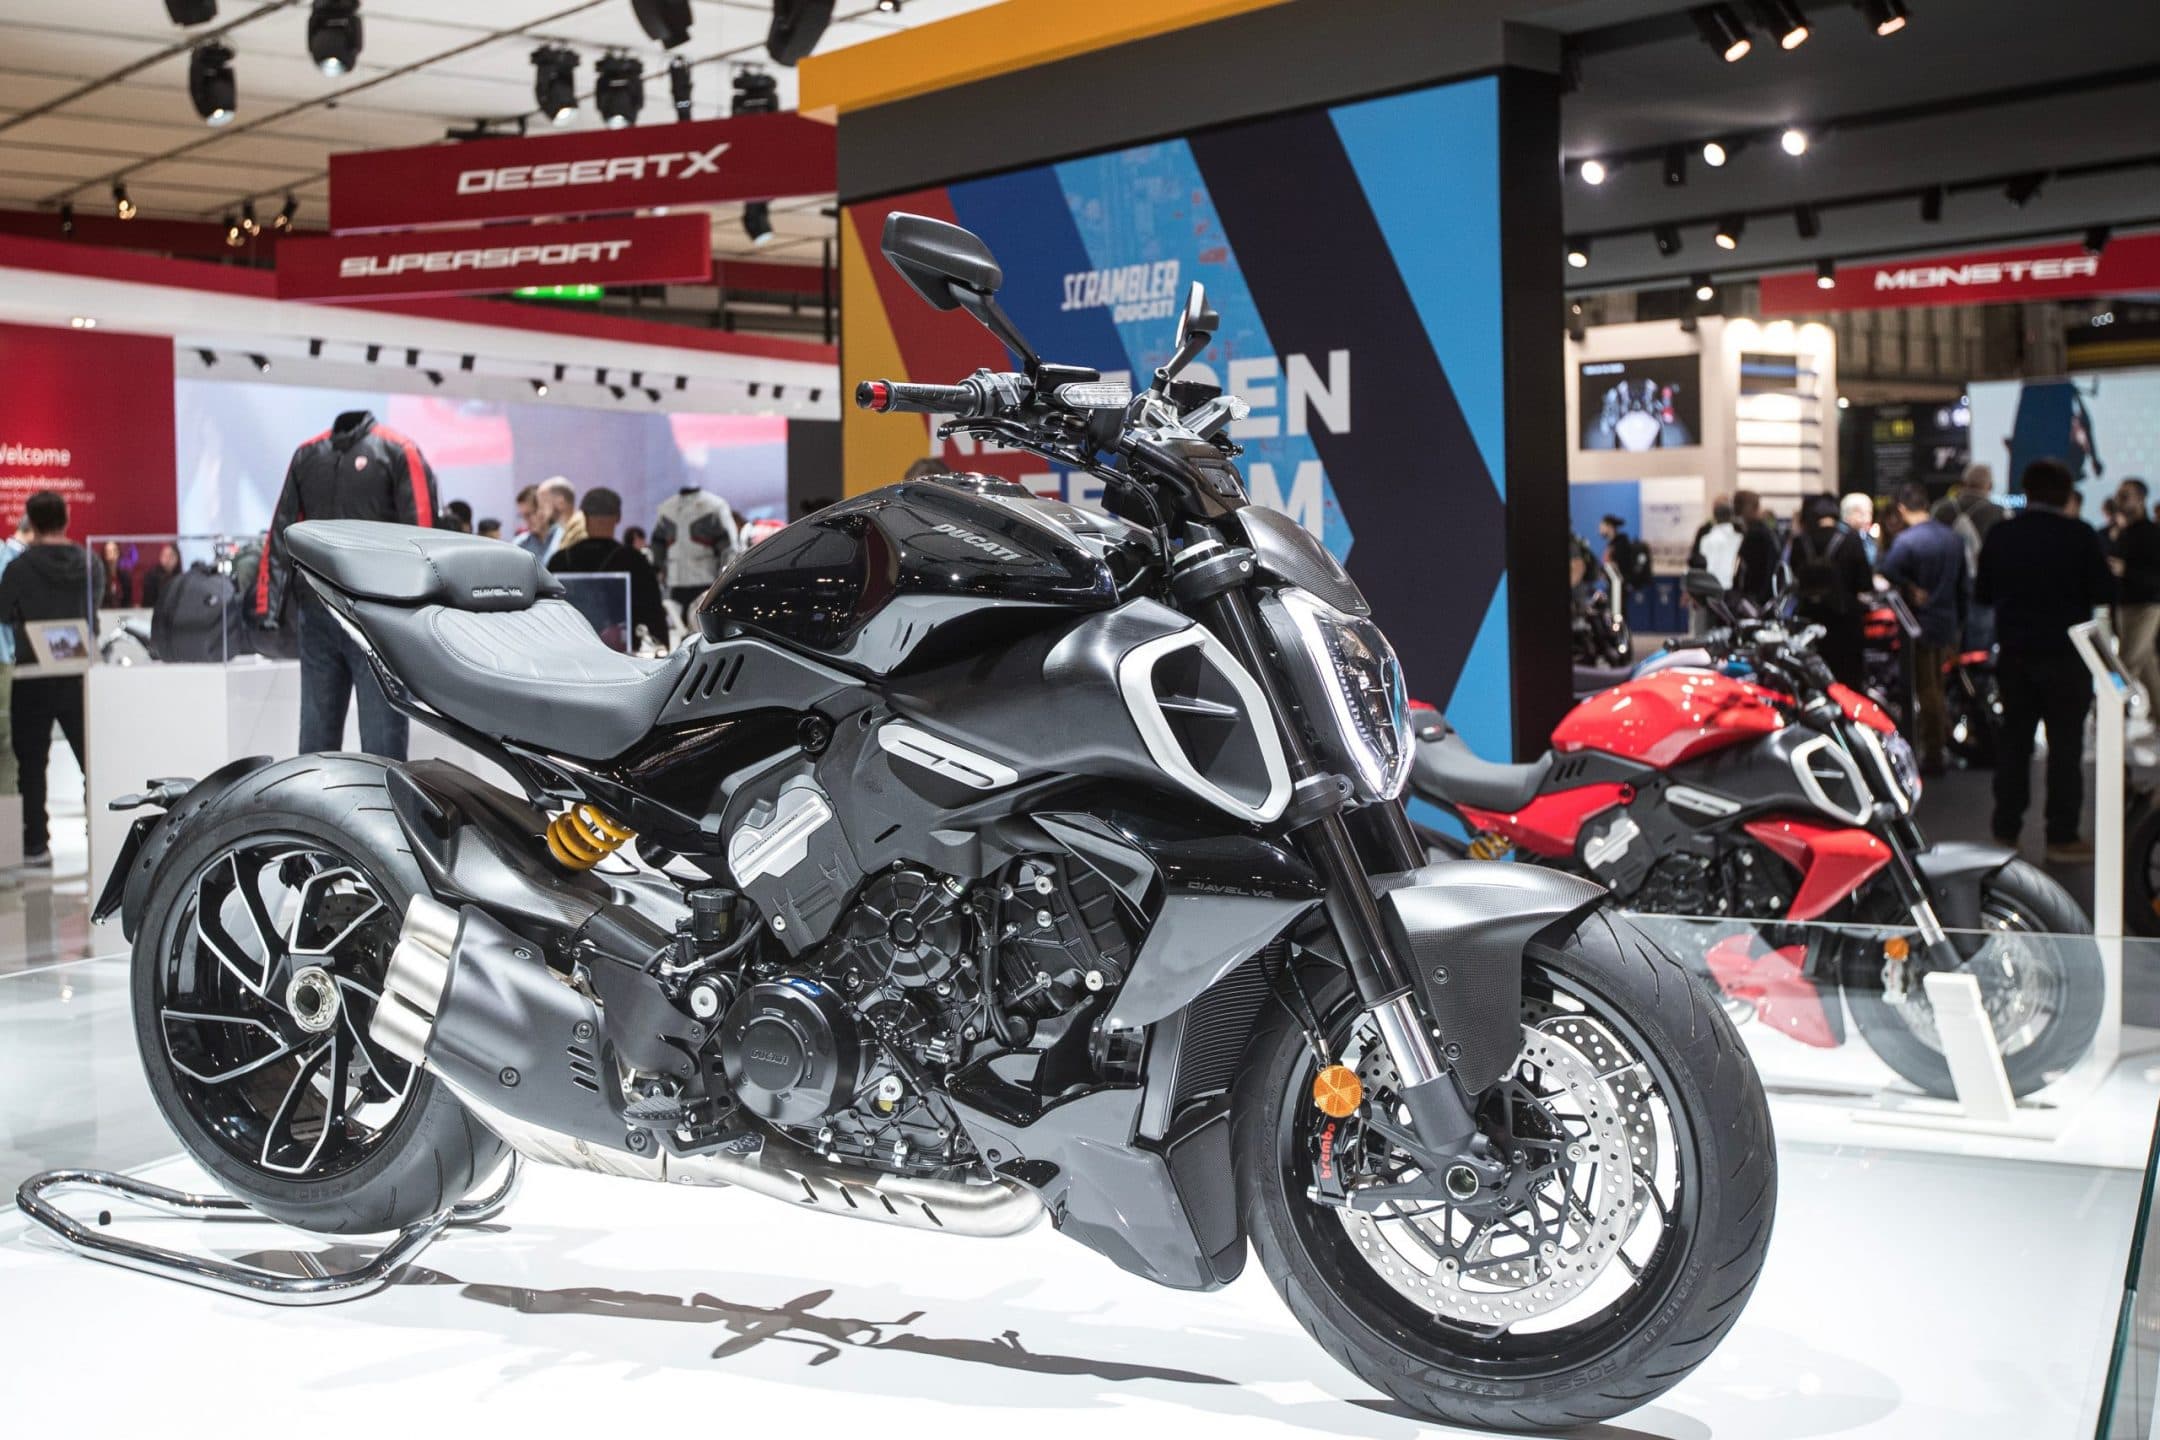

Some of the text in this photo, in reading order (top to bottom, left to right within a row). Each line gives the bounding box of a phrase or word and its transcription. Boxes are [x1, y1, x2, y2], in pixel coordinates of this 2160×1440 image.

[457, 143, 731, 195] DESERTX
[339, 240, 632, 278] SUPERSPORT
[1874, 255, 2099, 291] MONSTER
[1060, 259, 1179, 311] SCRAMBLER
[1112, 300, 1174, 324] DUCATI
[932, 523, 1022, 561] DUCATI
[1188, 881, 1249, 896] DIAVEL
[1320, 1122, 1336, 1179] brembo
